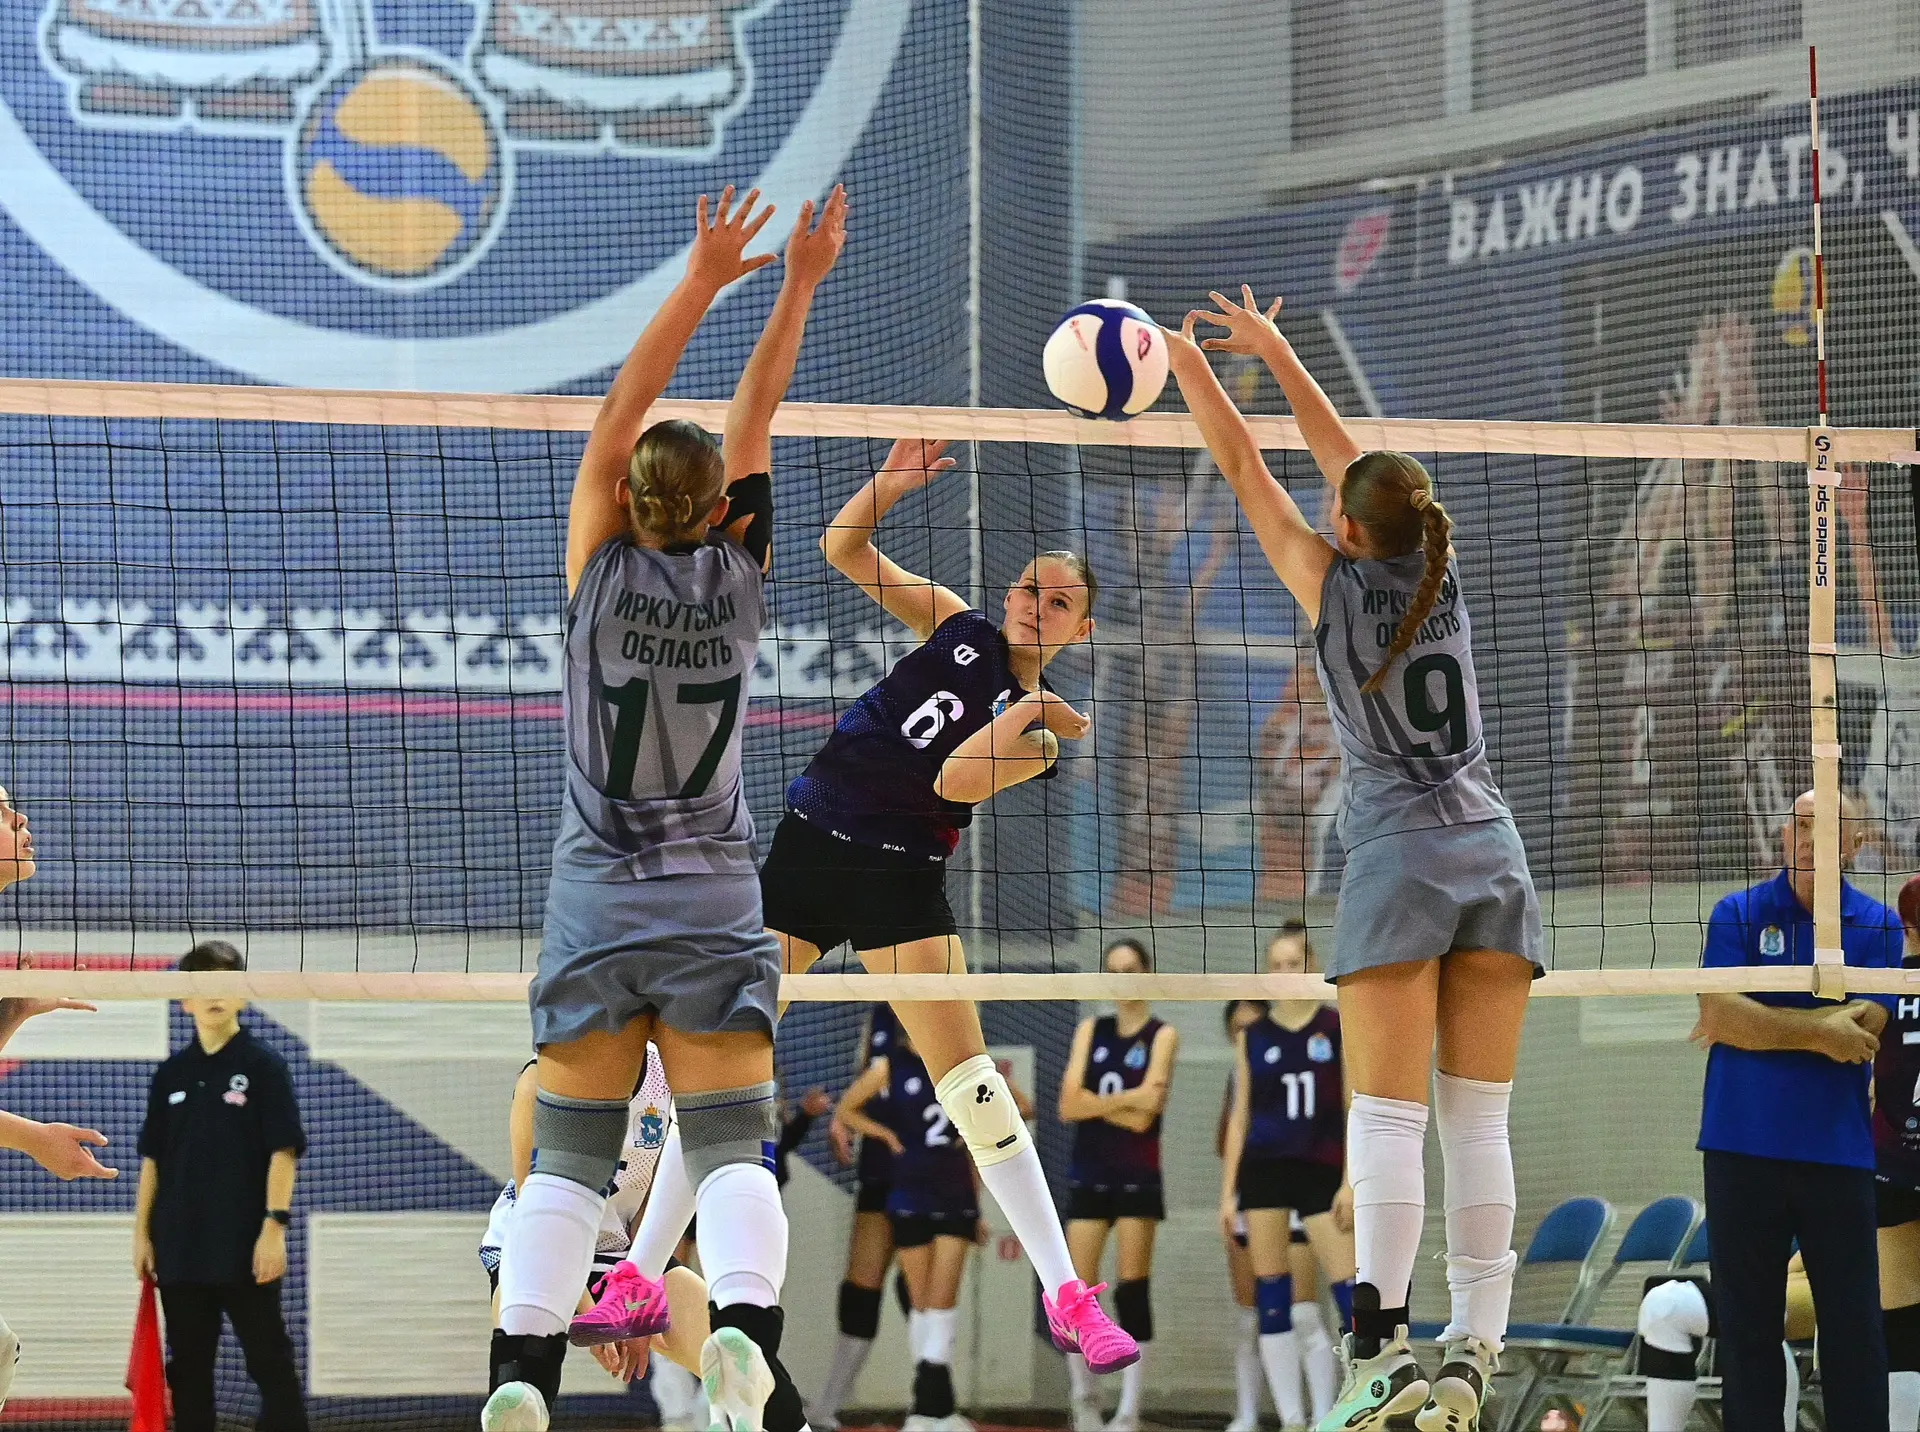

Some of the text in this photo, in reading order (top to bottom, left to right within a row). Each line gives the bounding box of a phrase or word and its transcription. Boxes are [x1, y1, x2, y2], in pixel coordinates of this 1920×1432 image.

[1447, 166, 1645, 264] ВАЖНО
[1670, 130, 1865, 223] ЗНАТЬ,
[1815, 454, 1831, 587] Schelde Spts
[621, 629, 733, 669] ОБЛАСТЬ
[1376, 610, 1461, 649] ОАСТЬ
[602, 672, 742, 801] 17
[900, 689, 965, 750] 6
[1403, 652, 1468, 758] 9
[1280, 1070, 1316, 1120] 11
